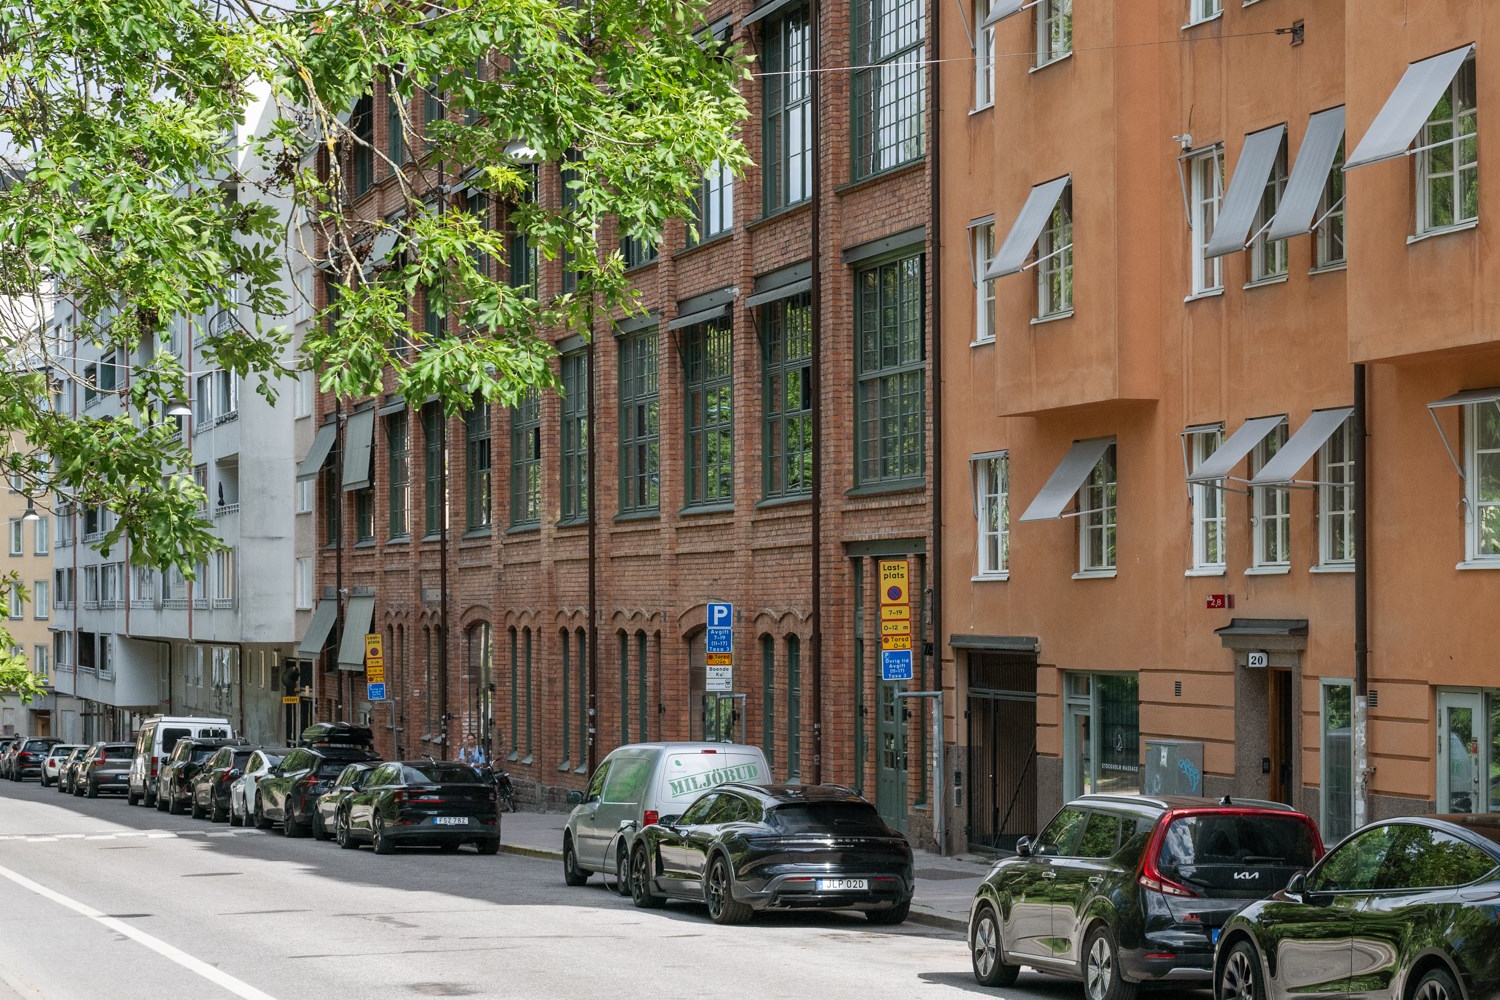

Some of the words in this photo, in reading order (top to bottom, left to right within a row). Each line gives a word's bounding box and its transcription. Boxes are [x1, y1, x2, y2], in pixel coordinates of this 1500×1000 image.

[884, 572, 905, 580] plats
[714, 605, 728, 625] P
[1251, 655, 1264, 665] 20
[669, 764, 759, 796] MILJÖBUD
[826, 880, 844, 889] JLP
[846, 879, 864, 889] 02D
